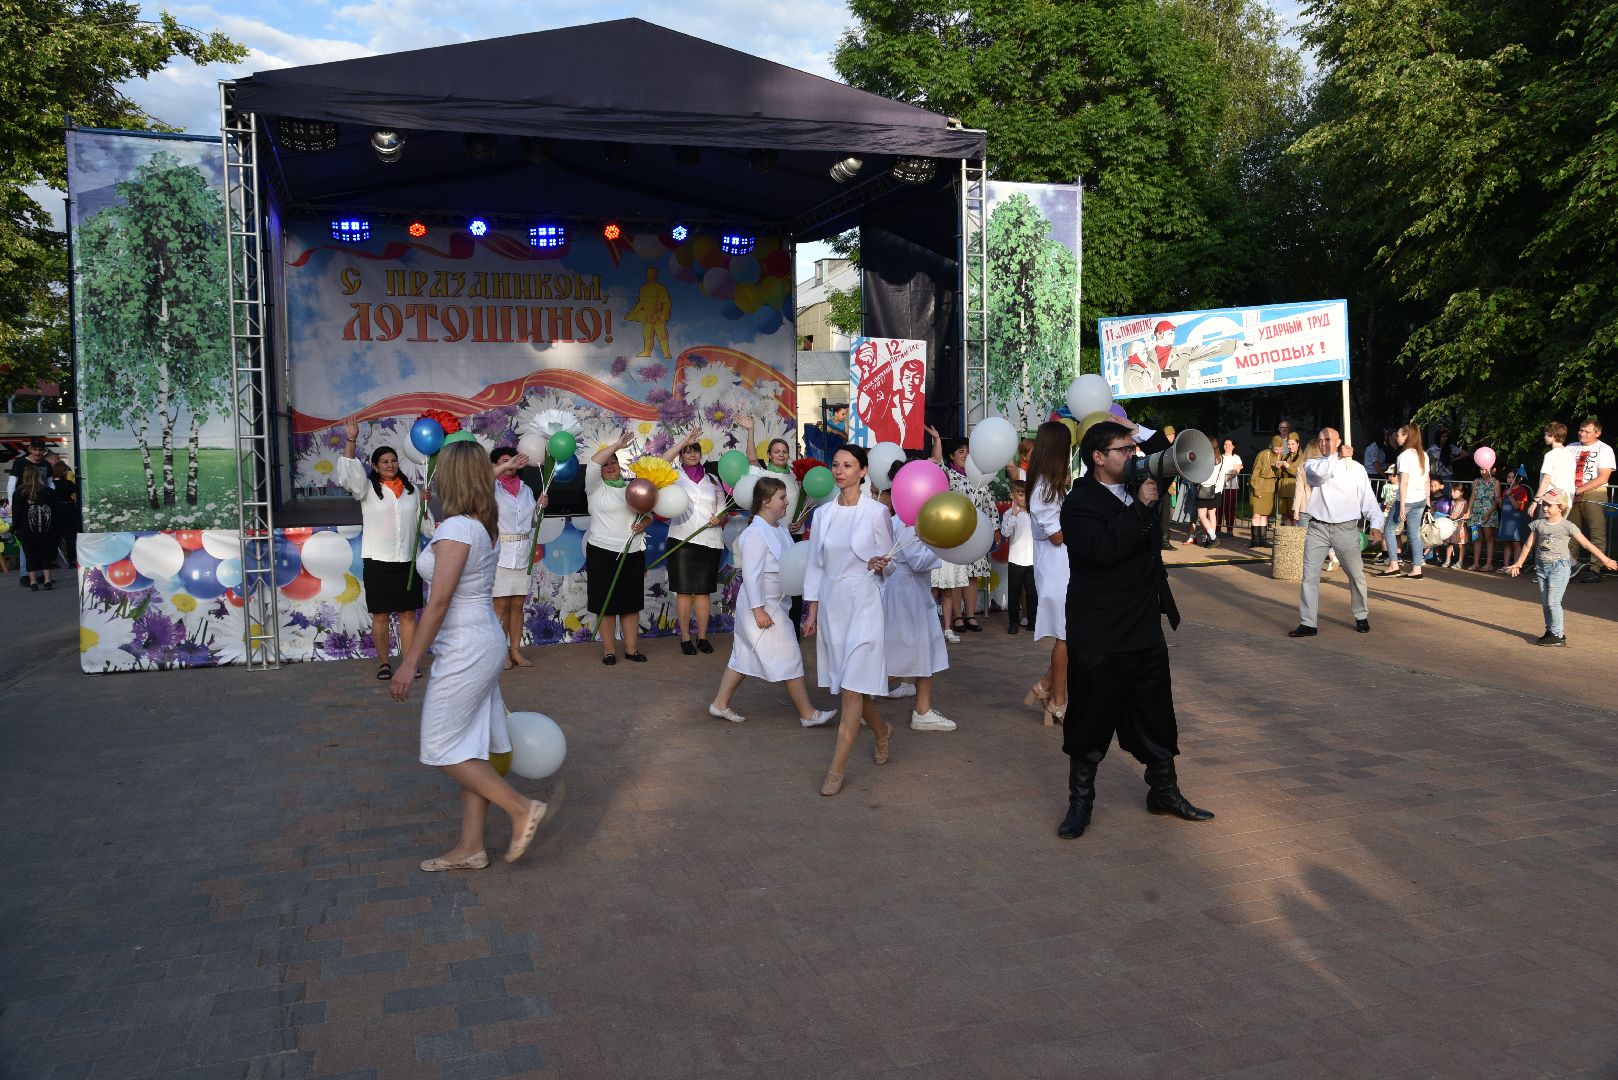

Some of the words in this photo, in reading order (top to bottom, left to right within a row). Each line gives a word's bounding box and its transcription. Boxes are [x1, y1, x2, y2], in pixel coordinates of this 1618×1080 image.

[341, 268, 361, 295] С
[385, 270, 609, 304] ПРАЗДНИКОМ,
[342, 303, 613, 343] ЛОТОШИНО!
[1258, 317, 1303, 341] УДАРНЫЙ
[1307, 312, 1331, 330] ТРУД
[1235, 343, 1315, 369] МОЛОДЫХ
